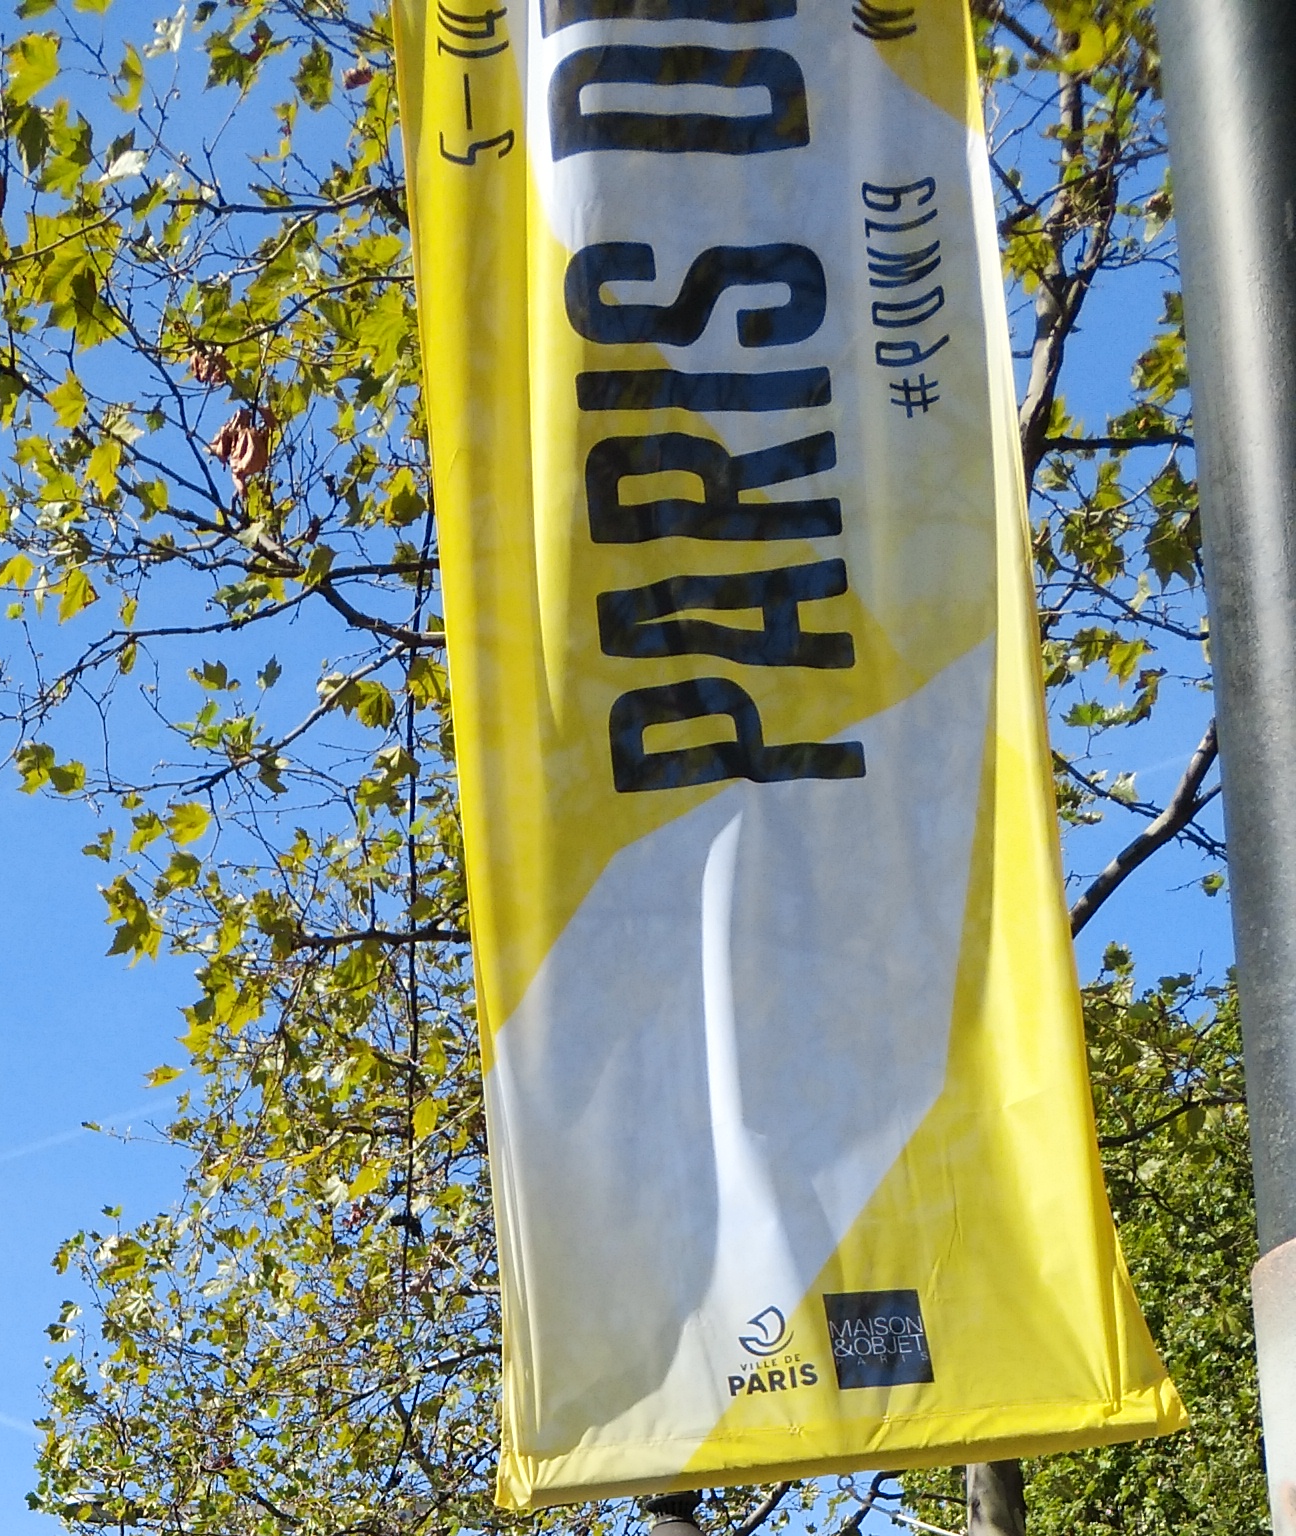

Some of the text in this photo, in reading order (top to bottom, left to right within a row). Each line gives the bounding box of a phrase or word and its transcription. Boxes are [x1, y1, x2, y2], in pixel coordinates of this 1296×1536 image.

[563, 241, 865, 793] PARIS
[829, 1315, 925, 1339] MAISON
[833, 1333, 923, 1359] &OBJET
[740, 1353, 802, 1372] VILLE DE
[836, 1353, 929, 1367] PARIS
[727, 1363, 819, 1397] PARIS
